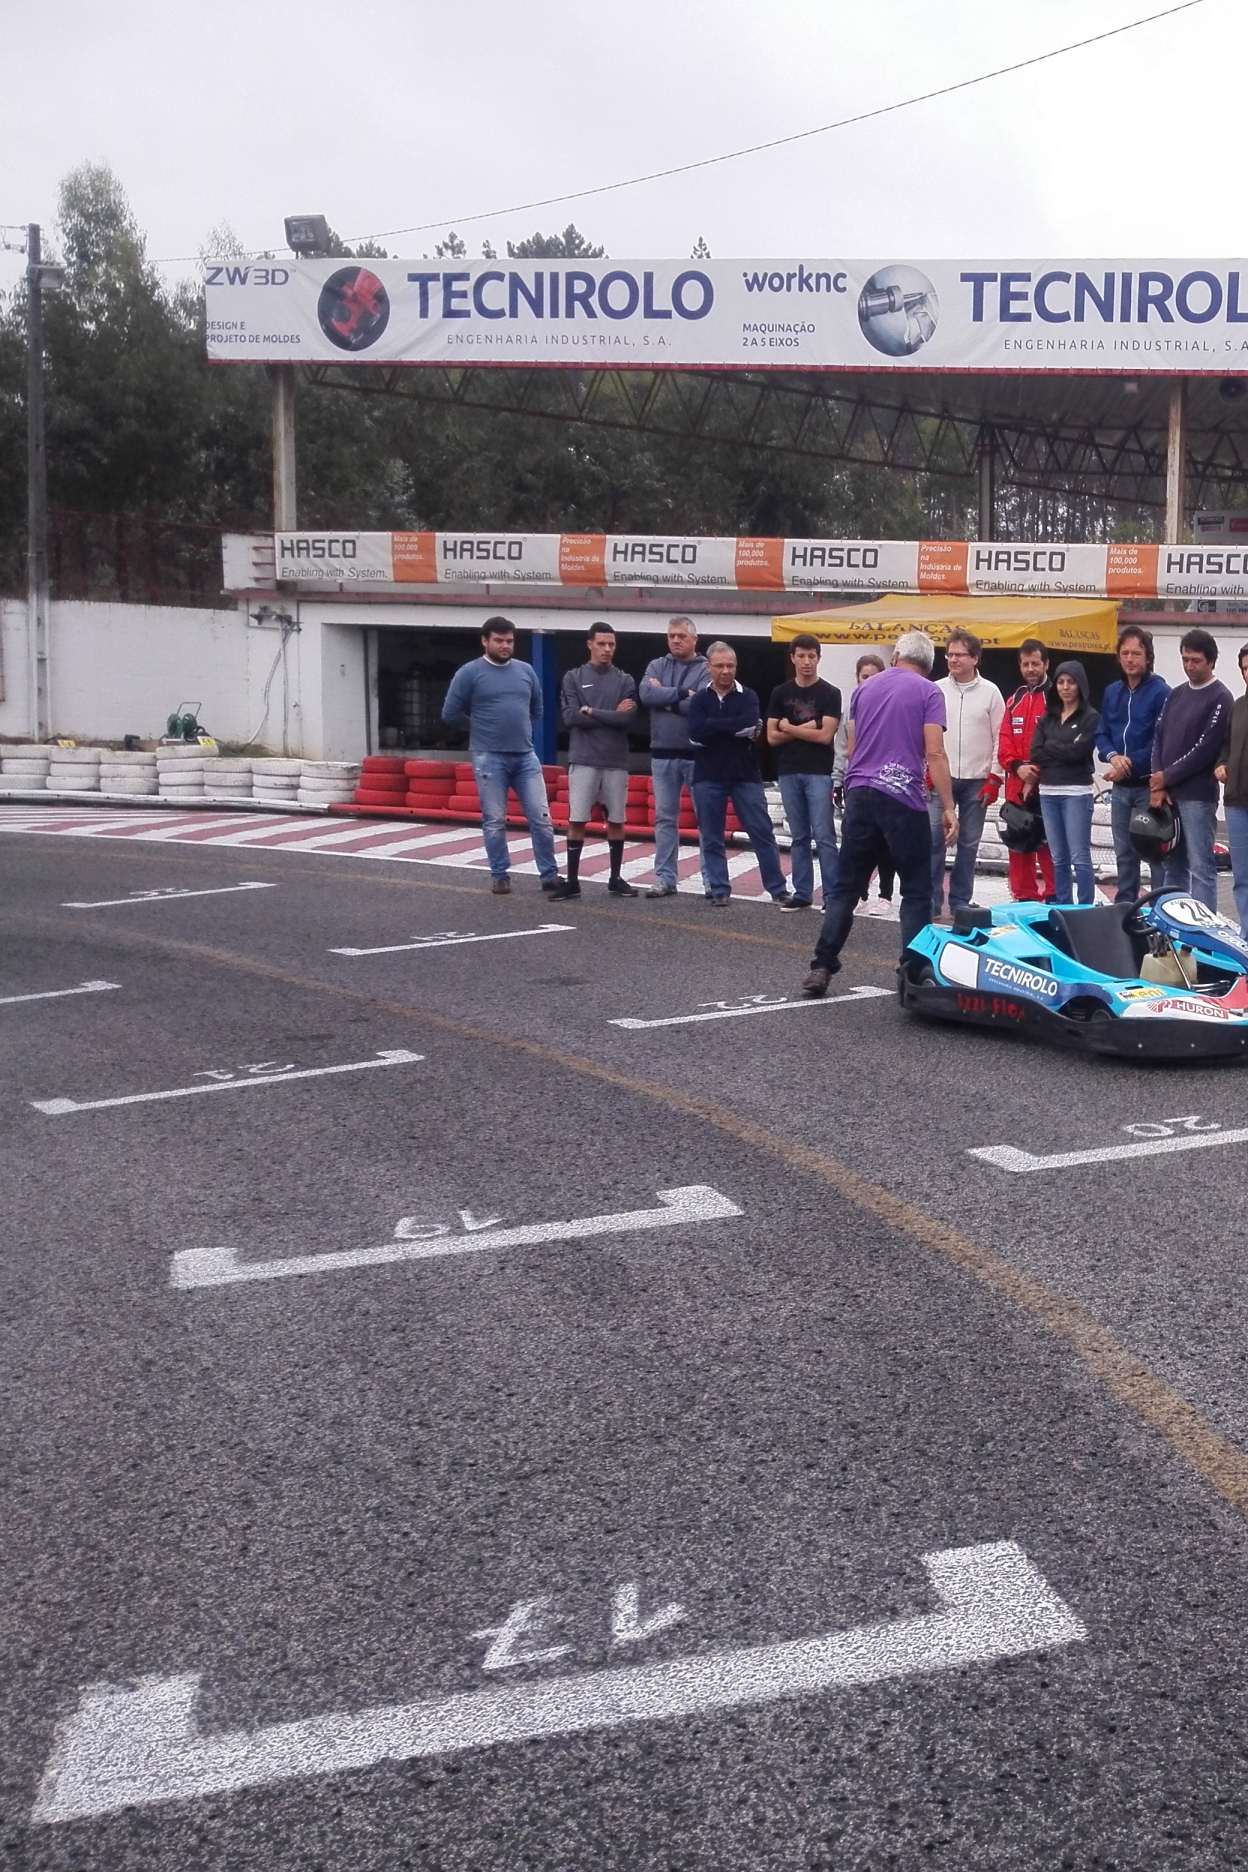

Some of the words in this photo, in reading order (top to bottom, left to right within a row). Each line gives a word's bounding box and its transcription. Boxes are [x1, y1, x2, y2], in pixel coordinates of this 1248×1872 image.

[742, 263, 848, 293] worknc
[407, 270, 715, 321] TECNIROLO
[240, 321, 246, 330] E
[742, 321, 816, 335] MAQUINAÇÃO
[204, 334, 247, 344] PROJETO
[248, 334, 261, 344] DE
[262, 334, 302, 344] MOLDES
[447, 333, 538, 345] ENGENHARIA
[545, 334, 636, 348] INDUSTRIAL,
[742, 337, 749, 347] 2
[750, 337, 759, 347] A
[760, 337, 767, 347] 5
[768, 337, 800, 347] EIXOS
[1003, 338, 1105, 351] ENGENHARIA
[1114, 339, 1216, 353] INDUSTRIAL,
[281, 539, 357, 559] HASCO
[442, 540, 523, 560] HASCO
[612, 542, 698, 564] HASCO
[1109, 547, 1128, 555] Mais
[1128, 547, 1138, 555] de
[791, 546, 879, 569] HASCO
[975, 549, 1066, 572] HASCO
[326, 568, 345, 578] with
[444, 568, 487, 581] Enabling
[489, 569, 510, 580] with
[613, 571, 660, 585] Enabling
[662, 573, 684, 583] with
[792, 576, 841, 589] Enabling
[842, 577, 865, 587] with
[975, 579, 1025, 592] Enabling
[1028, 581, 1050, 591] with
[1166, 583, 1217, 596] Enabling
[1220, 584, 1245, 595] with
[1179, 901, 1213, 922] 24
[984, 958, 1058, 997] TECNIROLO
[697, 994, 788, 1010] 22
[1176, 1002, 1225, 1019] HURON
[192, 1061, 296, 1080] 21
[1121, 1115, 1222, 1137] 20
[393, 1209, 505, 1239] 19
[466, 1582, 690, 1671] 17
